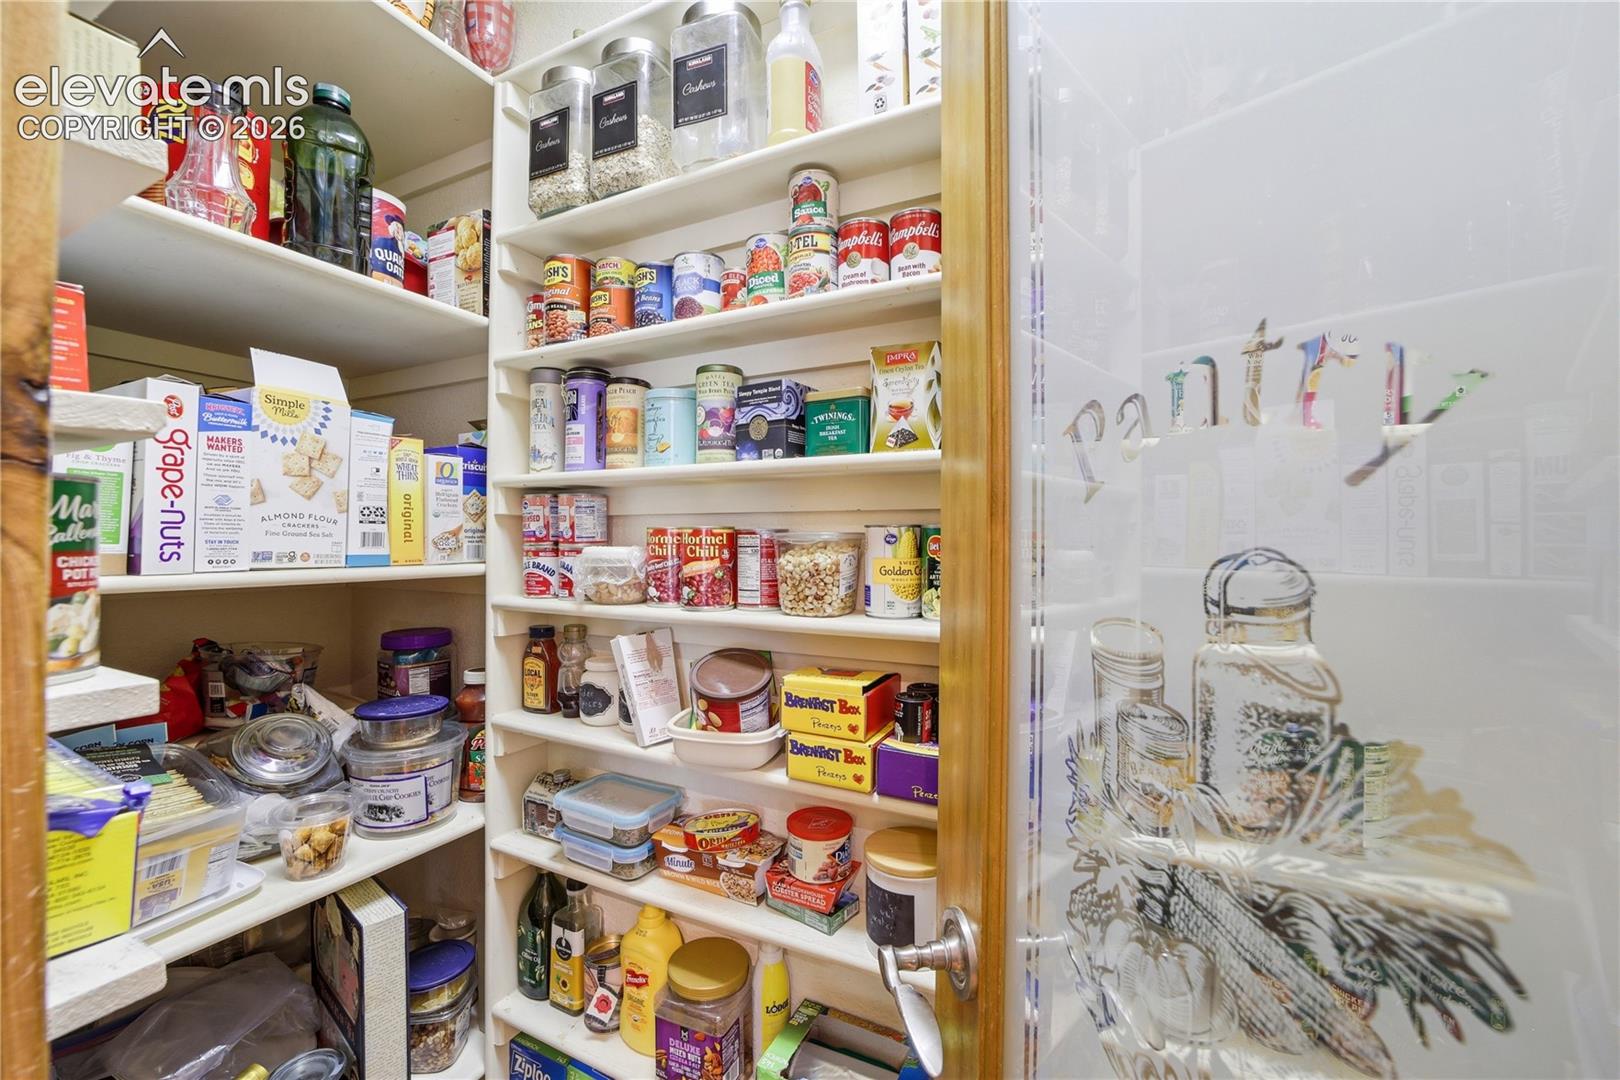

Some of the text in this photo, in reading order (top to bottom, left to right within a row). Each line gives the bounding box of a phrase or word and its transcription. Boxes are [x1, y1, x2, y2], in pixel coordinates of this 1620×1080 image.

[682, 79, 717, 96] Cashews
[599, 112, 628, 129] Cashews
[535, 136, 561, 152] Cashews
[794, 206, 826, 218] Sauce
[912, 262, 927, 270] with
[748, 272, 779, 289] Diced
[843, 273, 861, 281] Cream
[886, 350, 917, 364] IMPRA
[264, 394, 306, 411] Simple
[271, 405, 300, 420] Mills
[812, 411, 853, 425] TWININGS
[202, 412, 249, 428] Buttermilk
[207, 435, 244, 446] MAKERS
[207, 443, 244, 454] WANTED
[96, 454, 127, 464] Thyme
[396, 462, 419, 473] WHEAT
[396, 470, 419, 482] THINS
[153, 428, 192, 564] grape-nuts
[260, 512, 339, 526] ALMOND FLOUR
[401, 493, 415, 543] original
[264, 529, 281, 537] Fine
[281, 530, 308, 538] Ground
[683, 533, 727, 545] Hormel
[648, 544, 677, 556] Chili
[686, 545, 719, 558] Chili
[531, 560, 557, 578] BRAND
[879, 565, 914, 576] Golden
[525, 668, 542, 679] LOCAL
[784, 691, 837, 714] BREAKFAST
[810, 717, 843, 732] Penzeys
[789, 739, 843, 763] BREAKFAST
[816, 766, 848, 781] Penzeys
[911, 785, 938, 800] Penze
[665, 855, 694, 869] Minute
[772, 885, 827, 906] LOBSTER SPREAD
[669, 1037, 701, 1056] DELUXE
